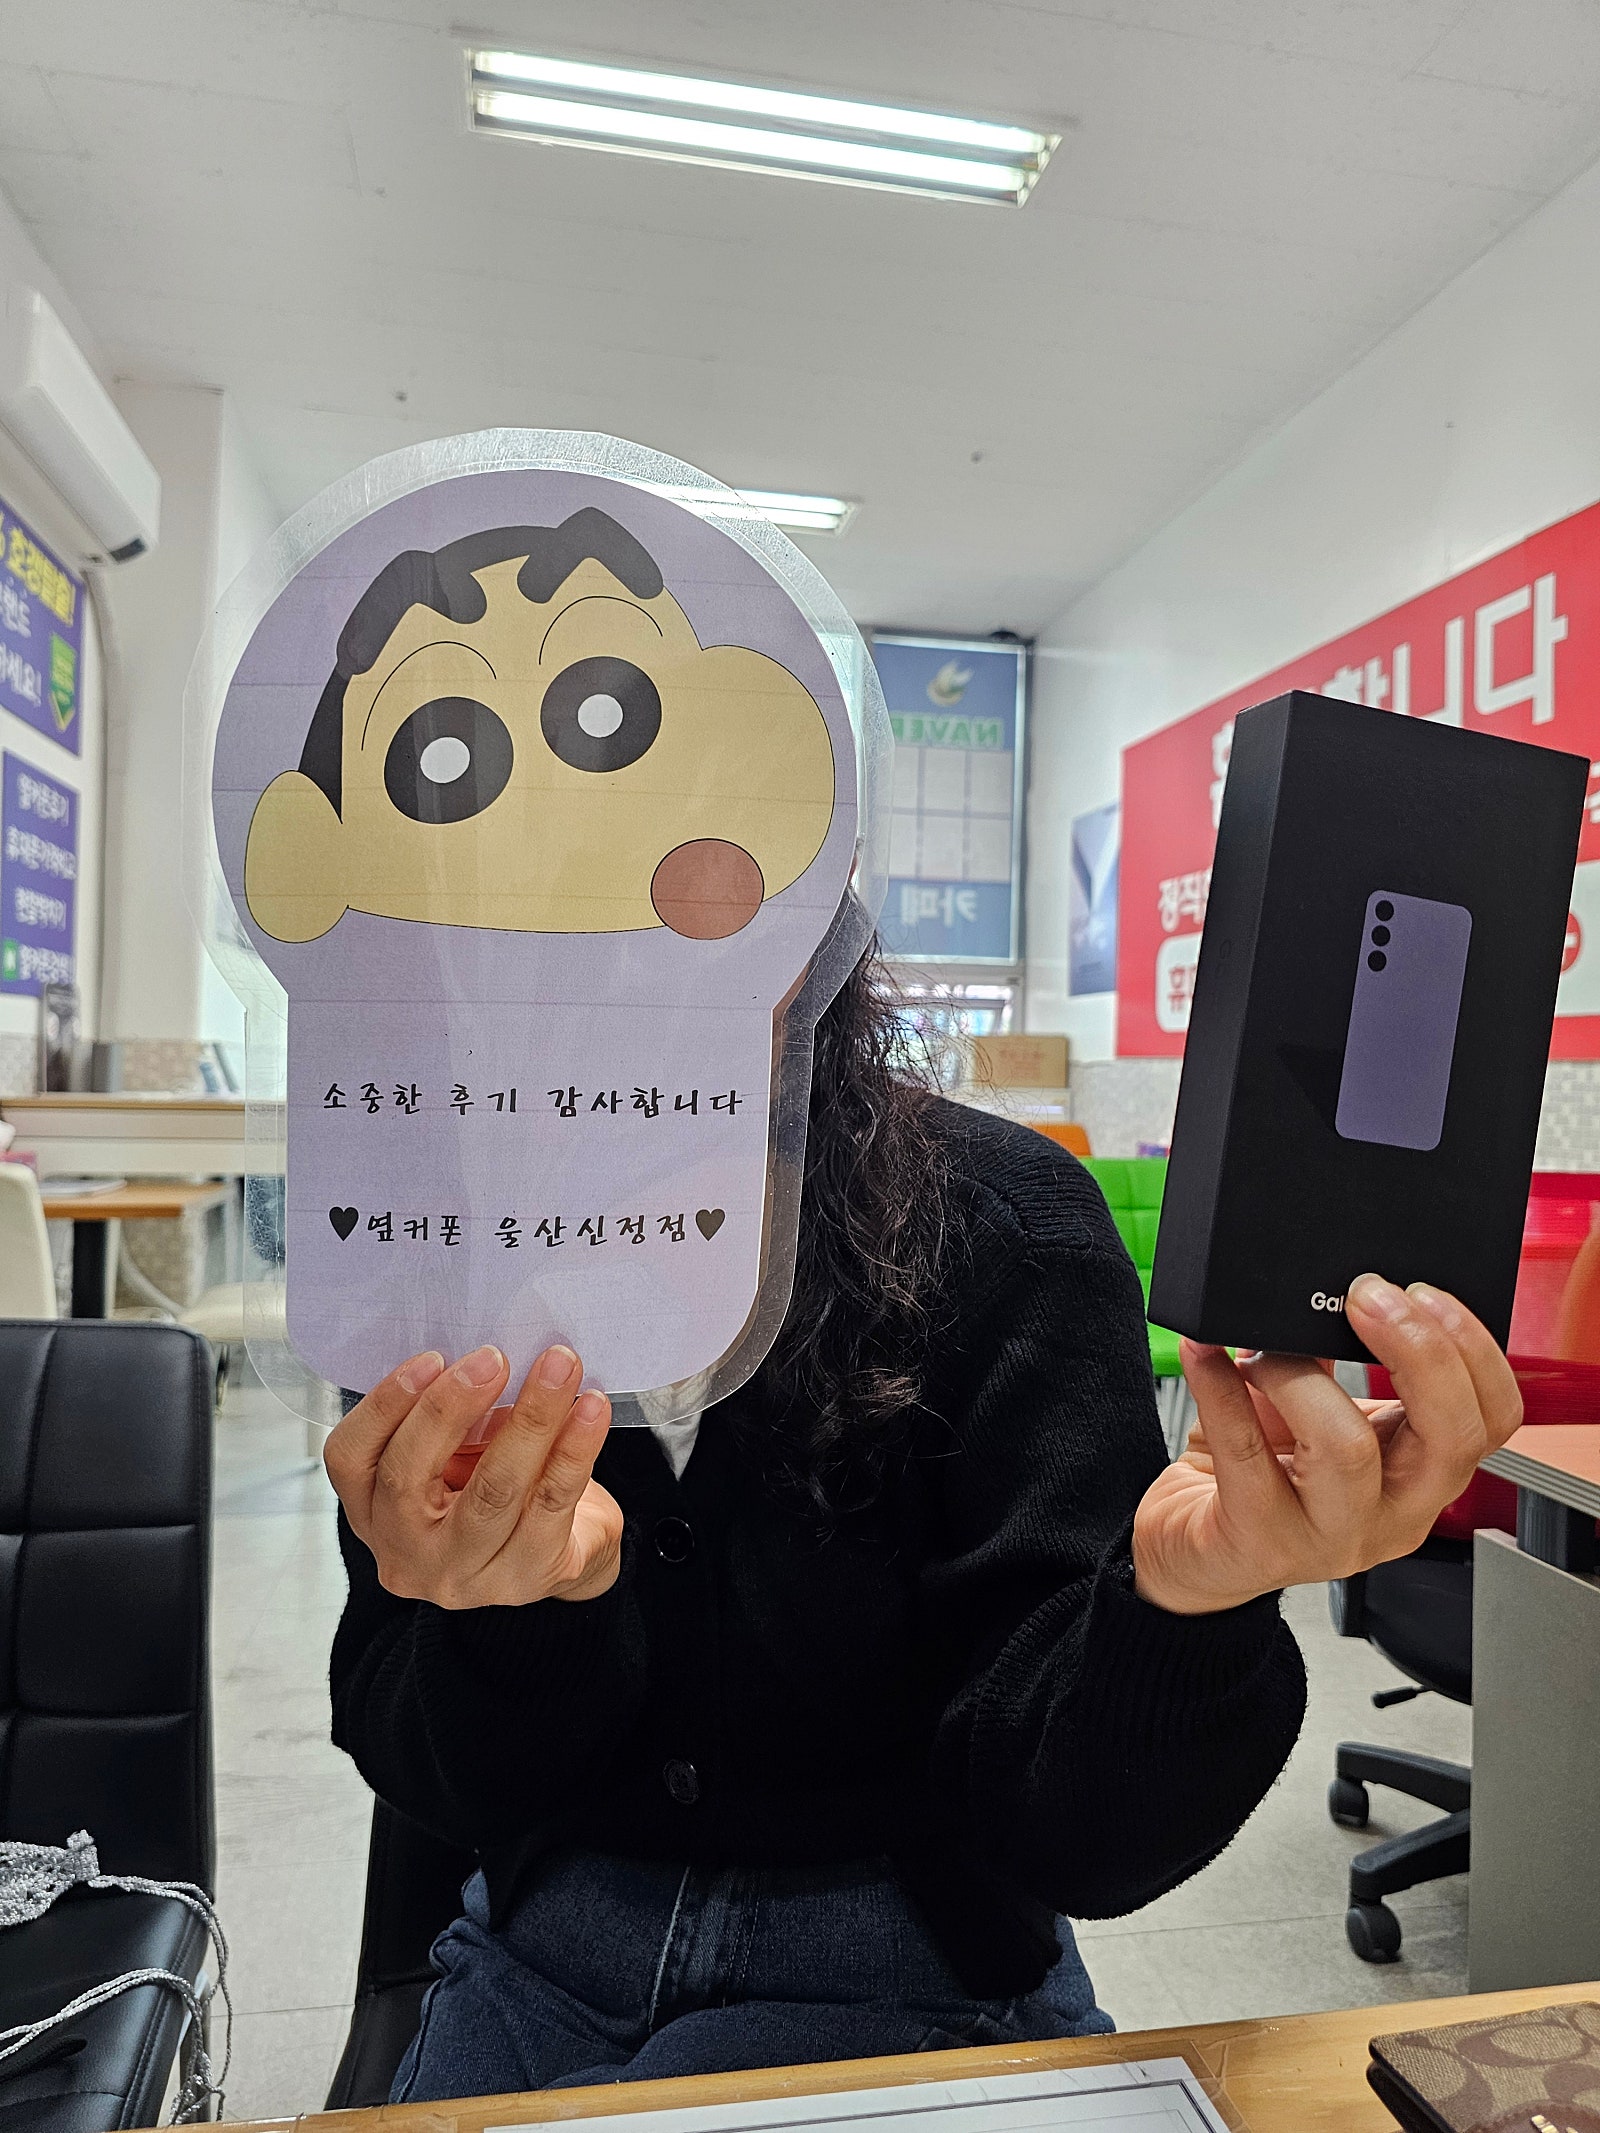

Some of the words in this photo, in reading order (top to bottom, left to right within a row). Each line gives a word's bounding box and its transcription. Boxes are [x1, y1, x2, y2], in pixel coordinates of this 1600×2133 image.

[323, 1082, 423, 1115] 소중한
[449, 1083, 518, 1116] 후기
[547, 1085, 743, 1119] 감사합니다
[494, 1213, 687, 1249] 울산신정점
[1310, 1291, 1346, 1313] Gal
